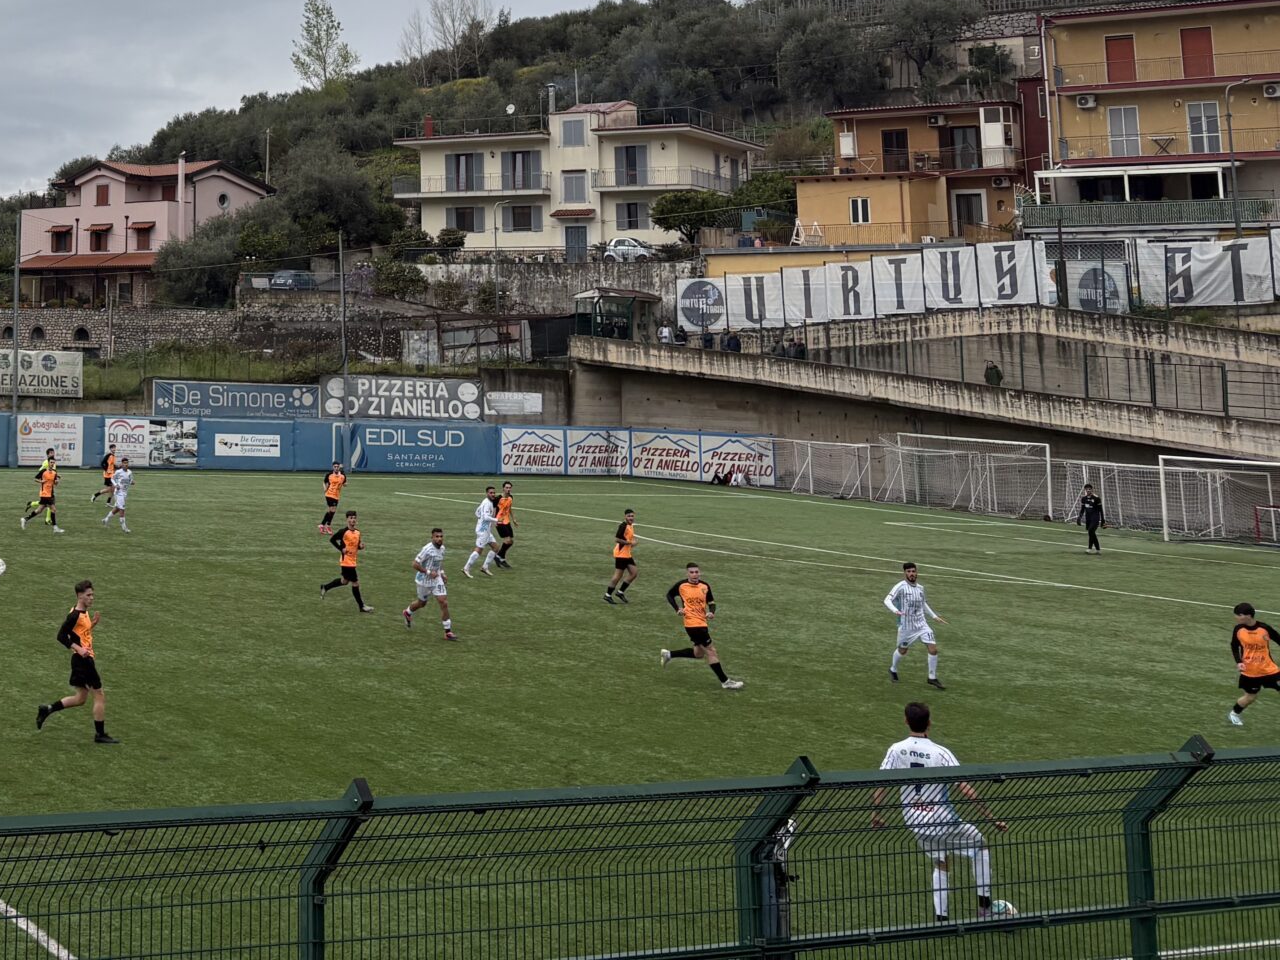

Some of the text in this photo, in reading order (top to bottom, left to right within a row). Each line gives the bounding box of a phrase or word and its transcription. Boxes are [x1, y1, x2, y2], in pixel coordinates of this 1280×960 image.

[72, 376, 79, 388] S
[358, 379, 448, 398] PIZZERIA
[172, 384, 286, 408] De Simone
[172, 406, 212, 416] le scarpe
[368, 397, 385, 415] ZI
[390, 398, 463, 418] ANIELLO
[32, 420, 66, 431] abagnale
[108, 432, 144, 444] DI RISO
[418, 430, 464, 448] SUD
[511, 444, 554, 453] PIZZERIA
[576, 444, 618, 454] PIZZERIA
[640, 446, 690, 458] PIZZERIA
[387, 453, 445, 462] SANTARPIA
[502, 454, 562, 467] O' ZI ANIELLO
[568, 456, 628, 468] O' ZI ANIELLO
[711, 450, 764, 462] PIZZERIA
[632, 456, 699, 473] O' ZI ANIELLO
[702, 462, 774, 478] O' ZI ANIELLO
[910, 750, 930, 760] mes
